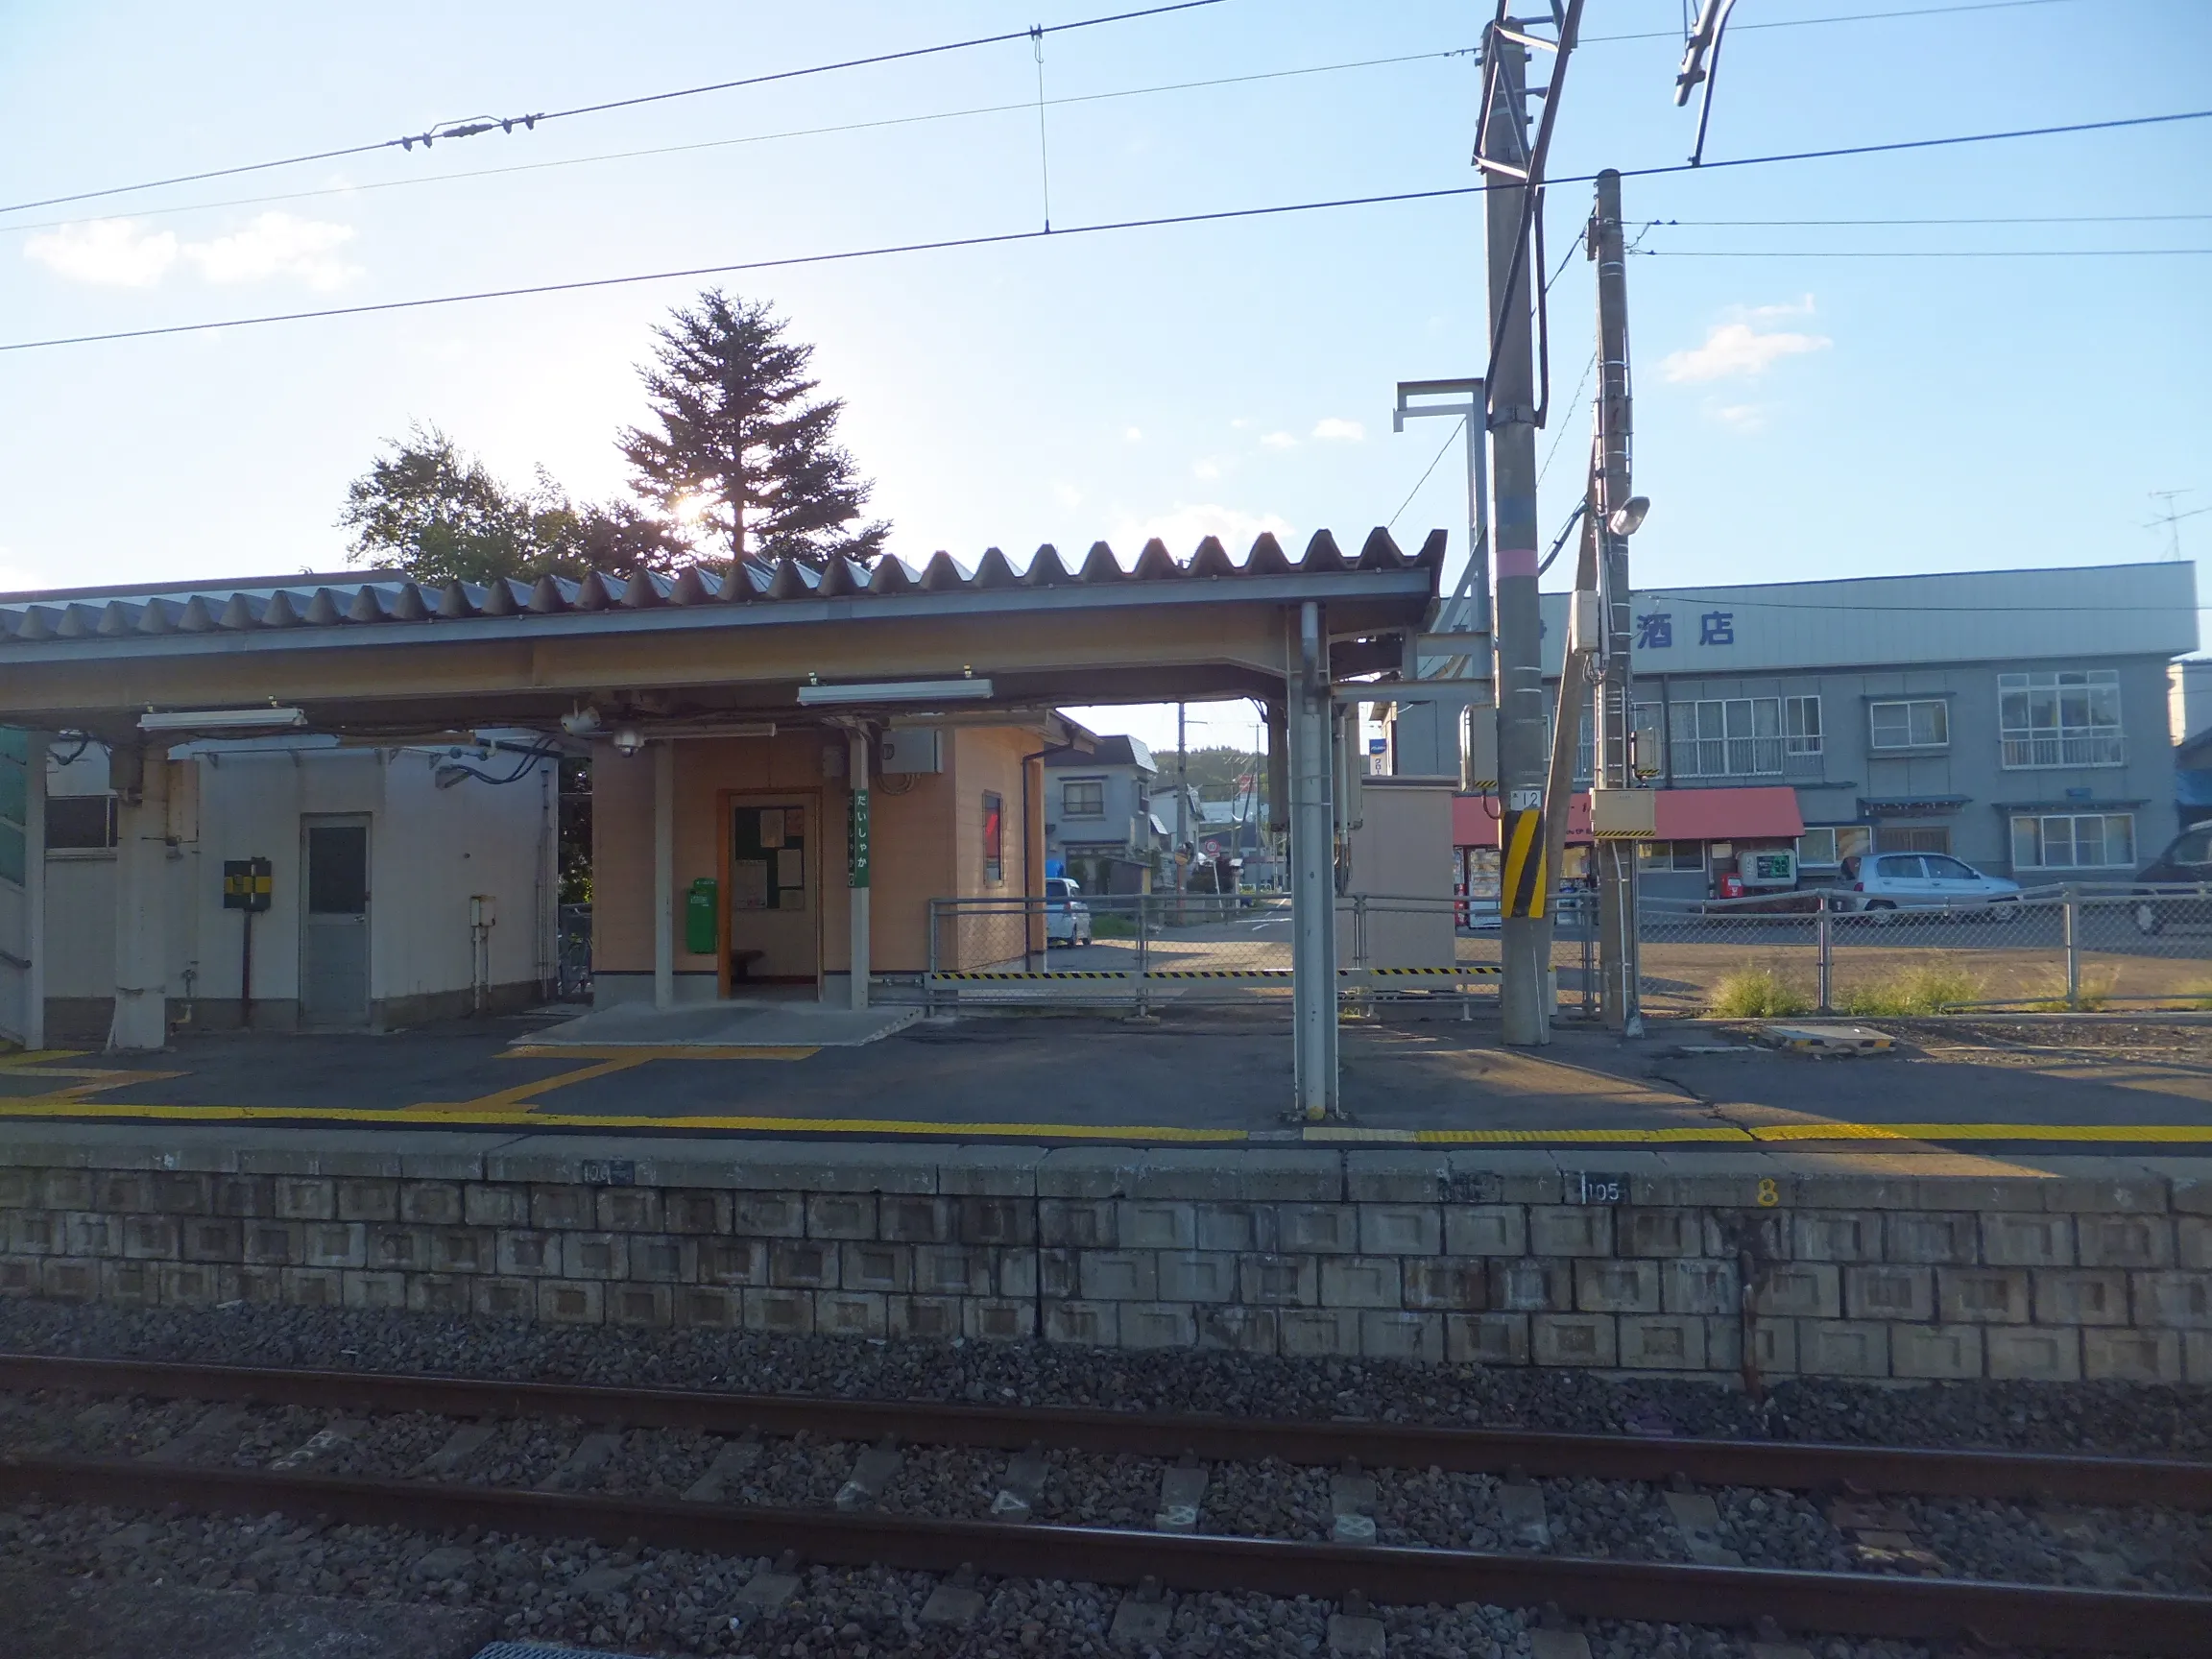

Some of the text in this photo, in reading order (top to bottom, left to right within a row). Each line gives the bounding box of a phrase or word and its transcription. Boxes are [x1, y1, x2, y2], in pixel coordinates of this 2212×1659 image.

[1637, 611, 1734, 649] 酒店
[1523, 792, 1538, 806] 12
[857, 795, 867, 868] だいしゃか
[1589, 1183, 1619, 1200] 105
[1758, 1178, 1778, 1207] 8
